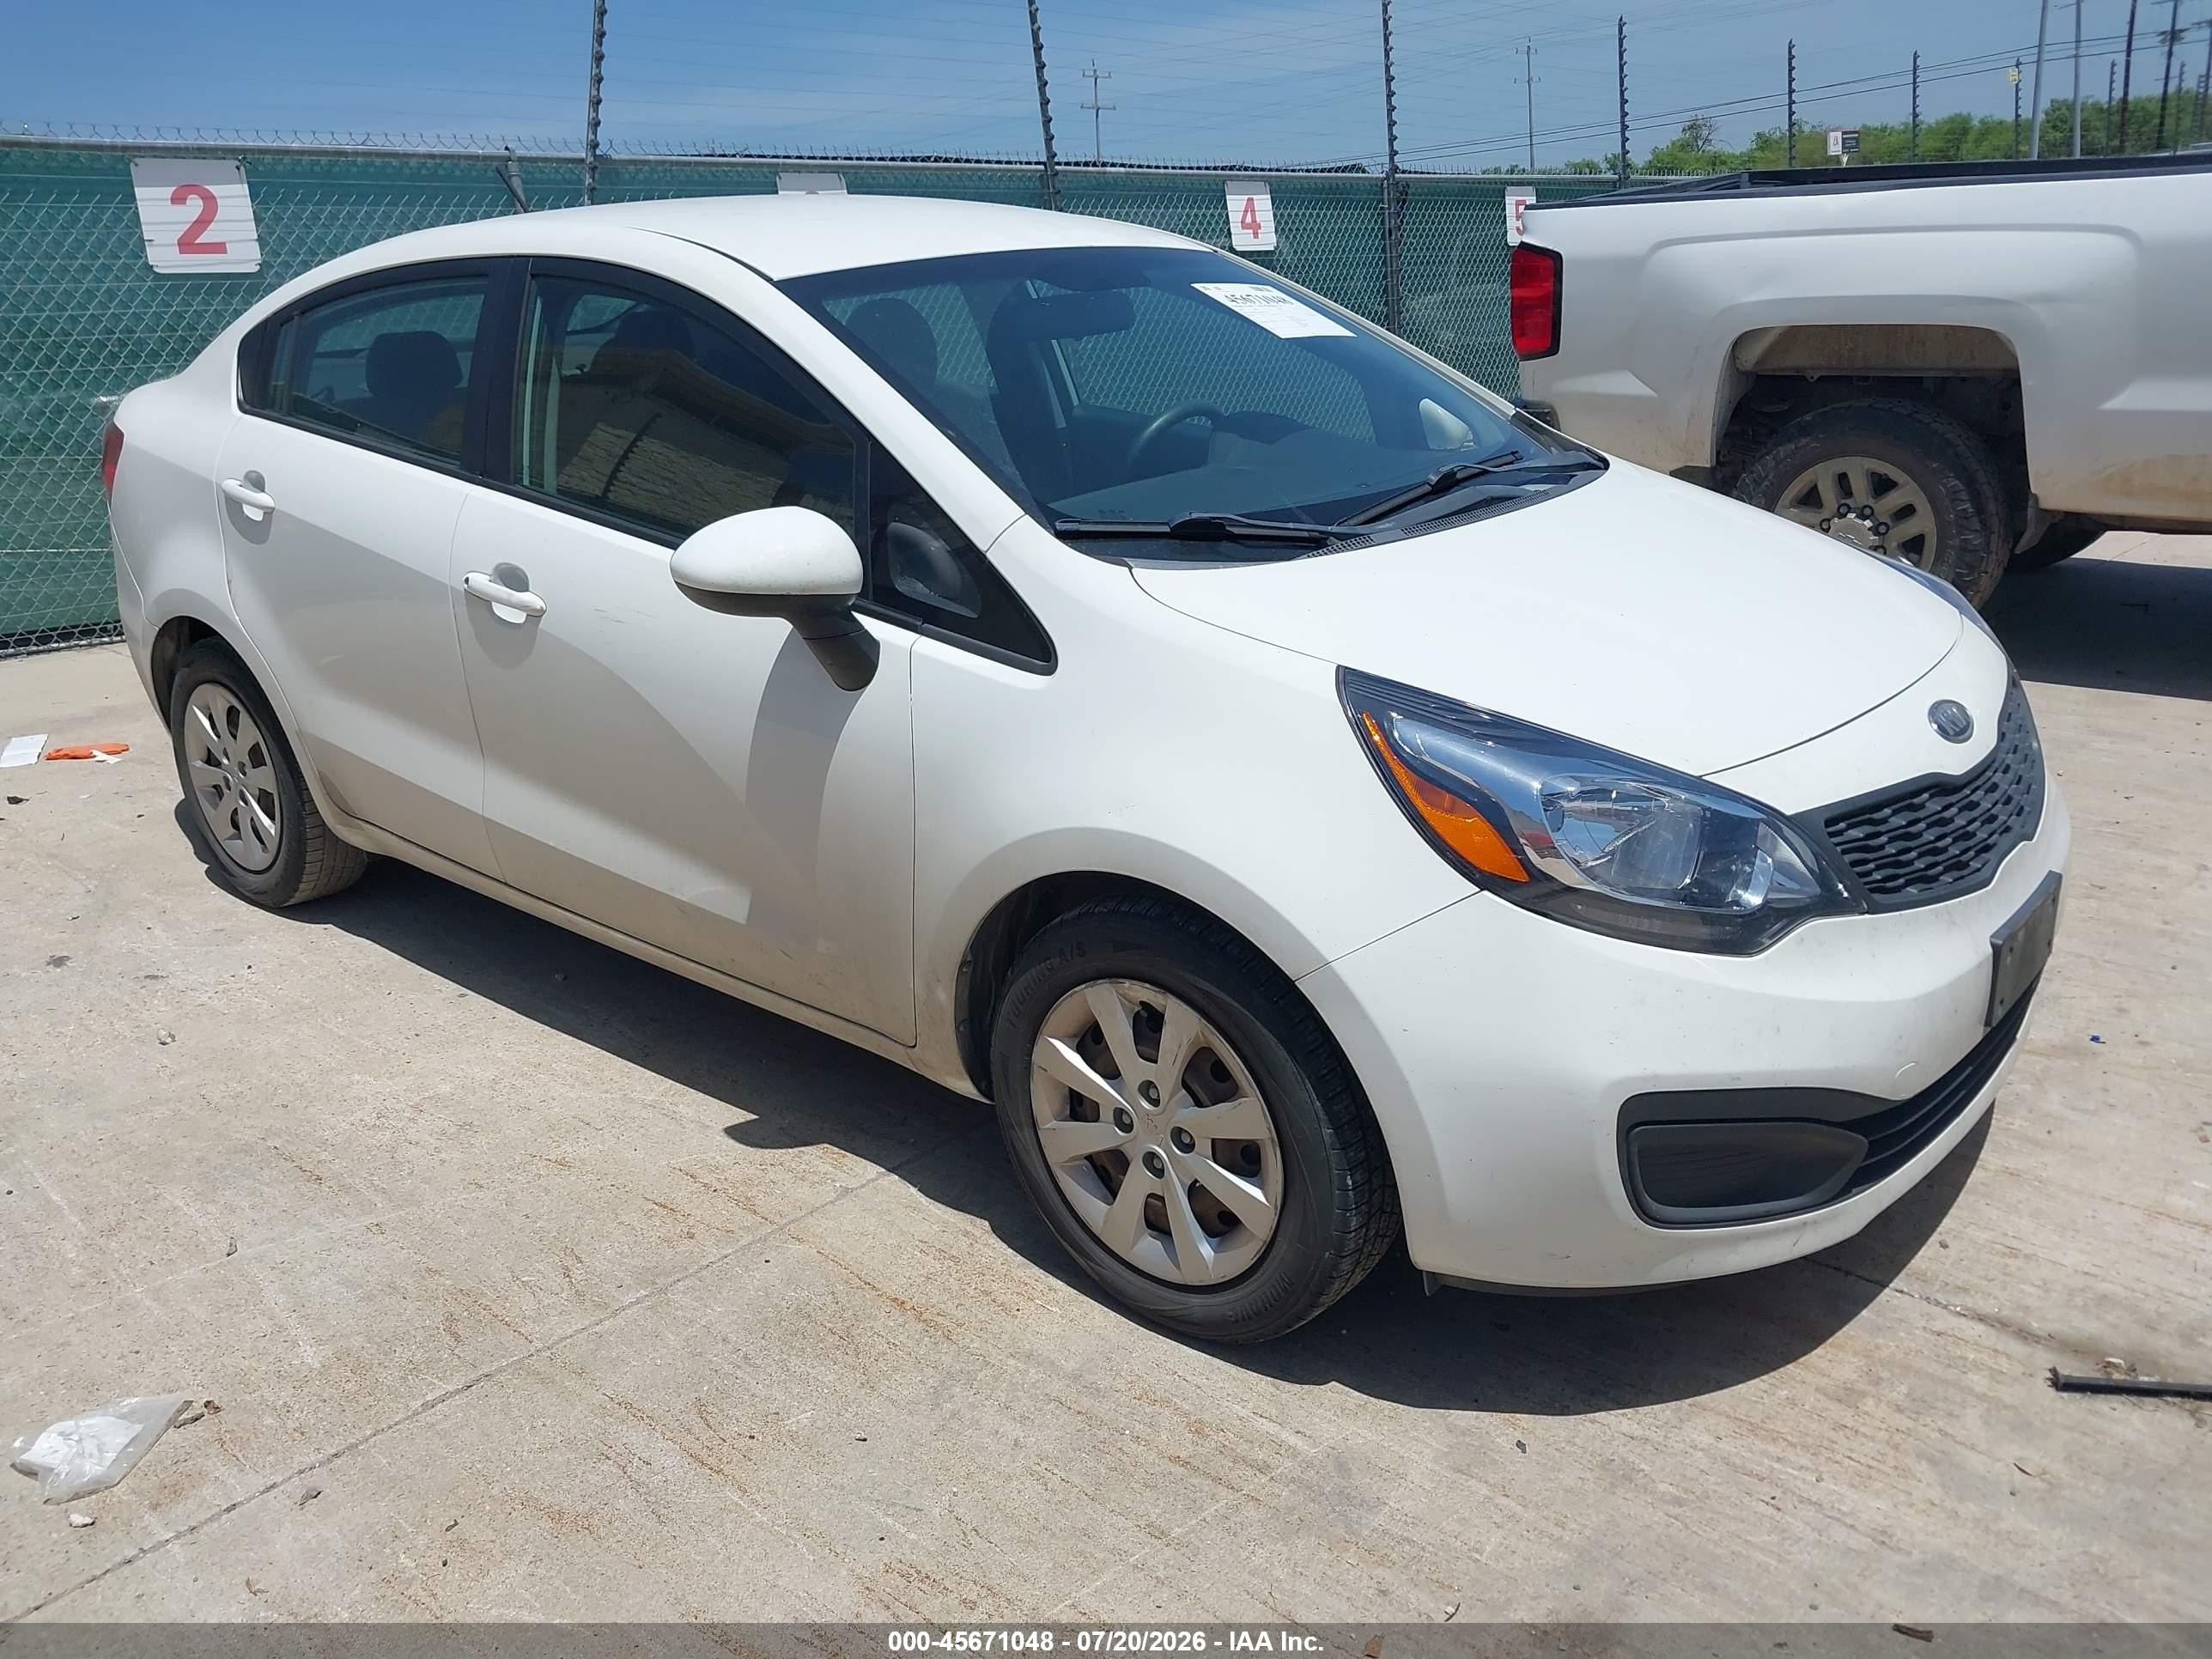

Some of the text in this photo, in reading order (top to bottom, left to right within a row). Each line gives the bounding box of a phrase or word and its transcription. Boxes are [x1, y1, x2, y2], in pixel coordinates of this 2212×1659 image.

[170, 183, 228, 255] 2
[1240, 197, 1261, 240] 4
[1058, 941, 1086, 963] A/S
